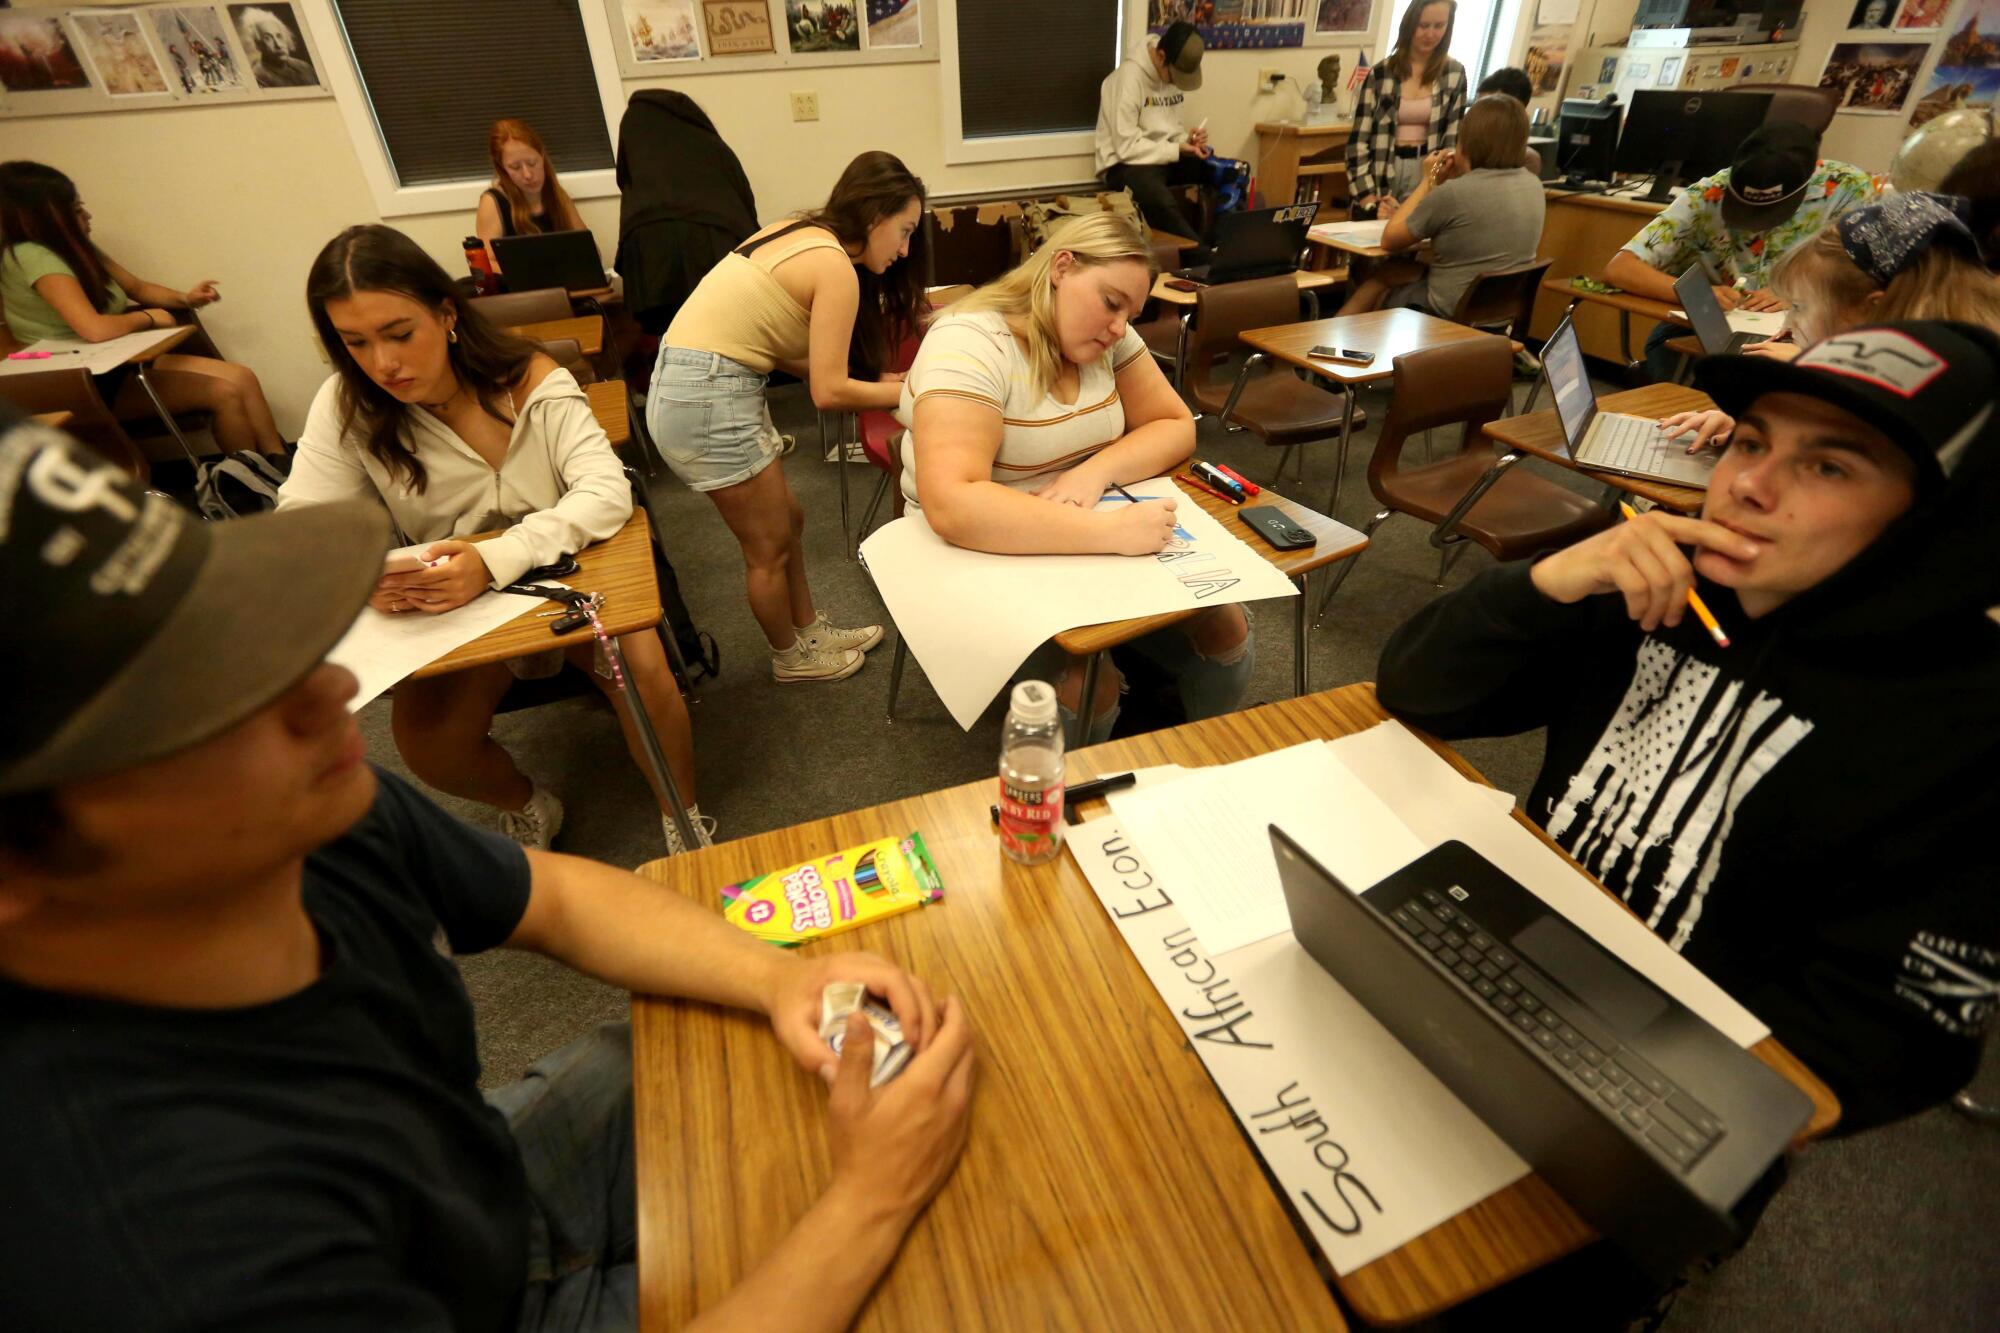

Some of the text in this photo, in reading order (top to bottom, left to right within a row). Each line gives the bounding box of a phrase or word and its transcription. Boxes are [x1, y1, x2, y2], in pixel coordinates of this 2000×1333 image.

[781, 870, 814, 932] PENCILS
[801, 864, 833, 930] COLORED
[875, 850, 900, 897] Crayola
[1101, 829, 1174, 919] Econ.
[750, 905, 770, 923] 12
[1162, 927, 1274, 1050] African
[1250, 1081, 1383, 1237] South
